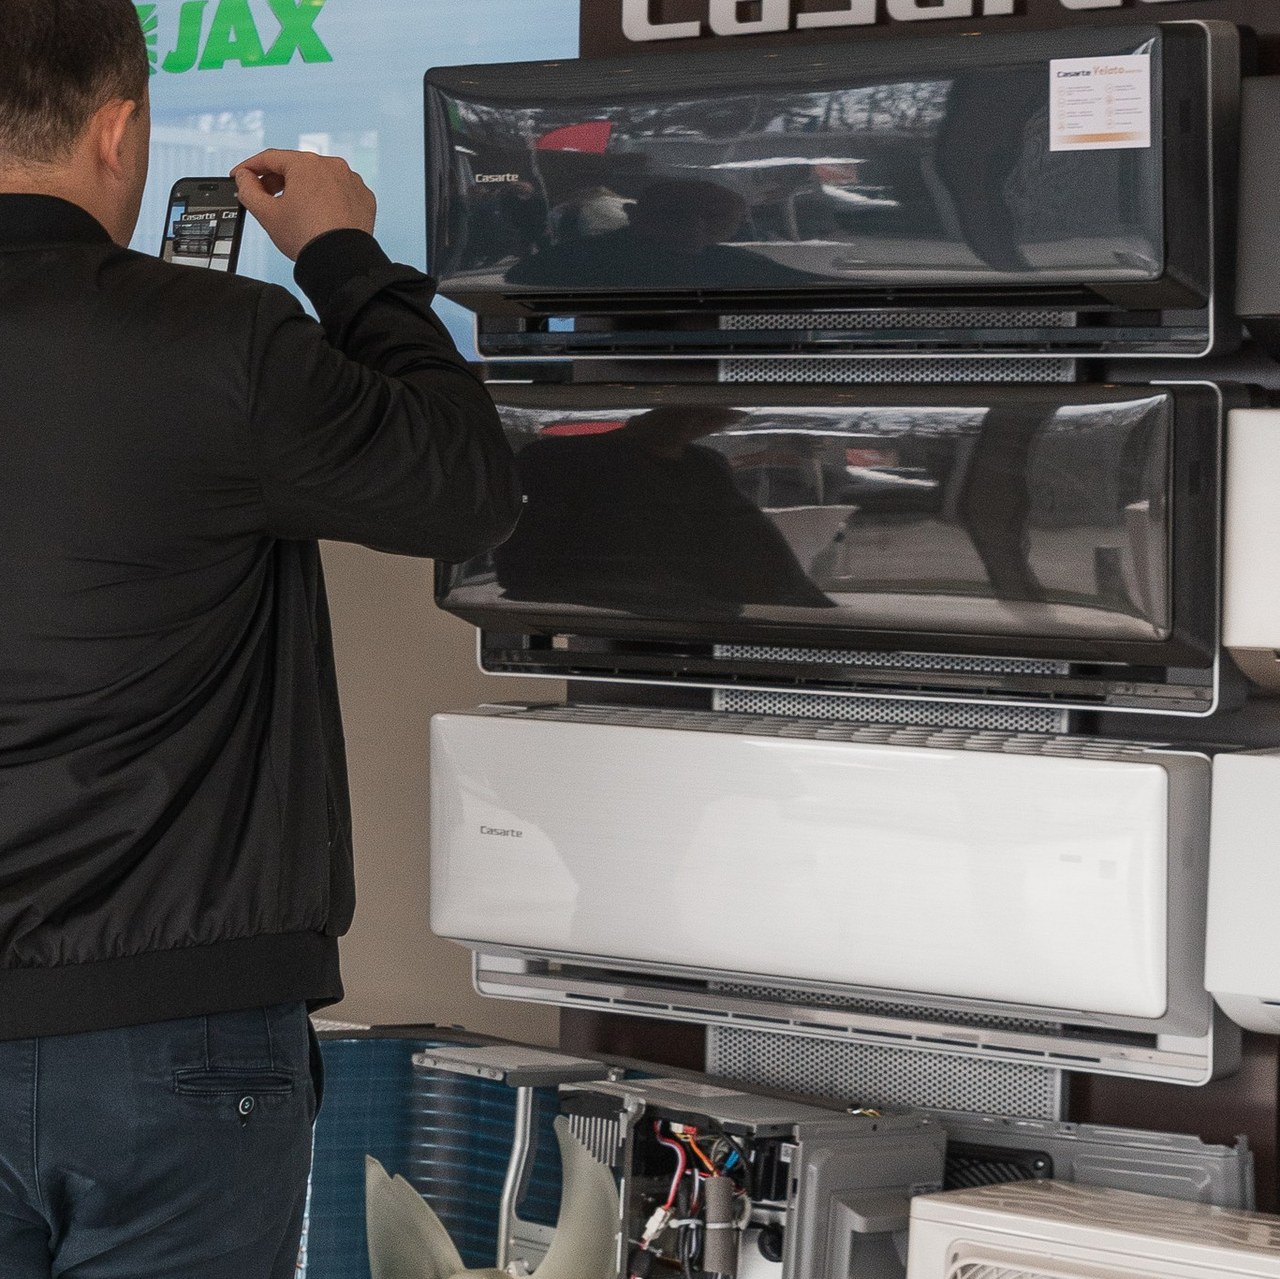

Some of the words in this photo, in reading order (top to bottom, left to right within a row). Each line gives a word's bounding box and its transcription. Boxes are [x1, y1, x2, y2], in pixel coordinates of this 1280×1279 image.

[1057, 70, 1091, 78] Casarte
[475, 173, 519, 183] Casarte
[182, 212, 216, 221] Casarte
[480, 825, 523, 838] Casarte
